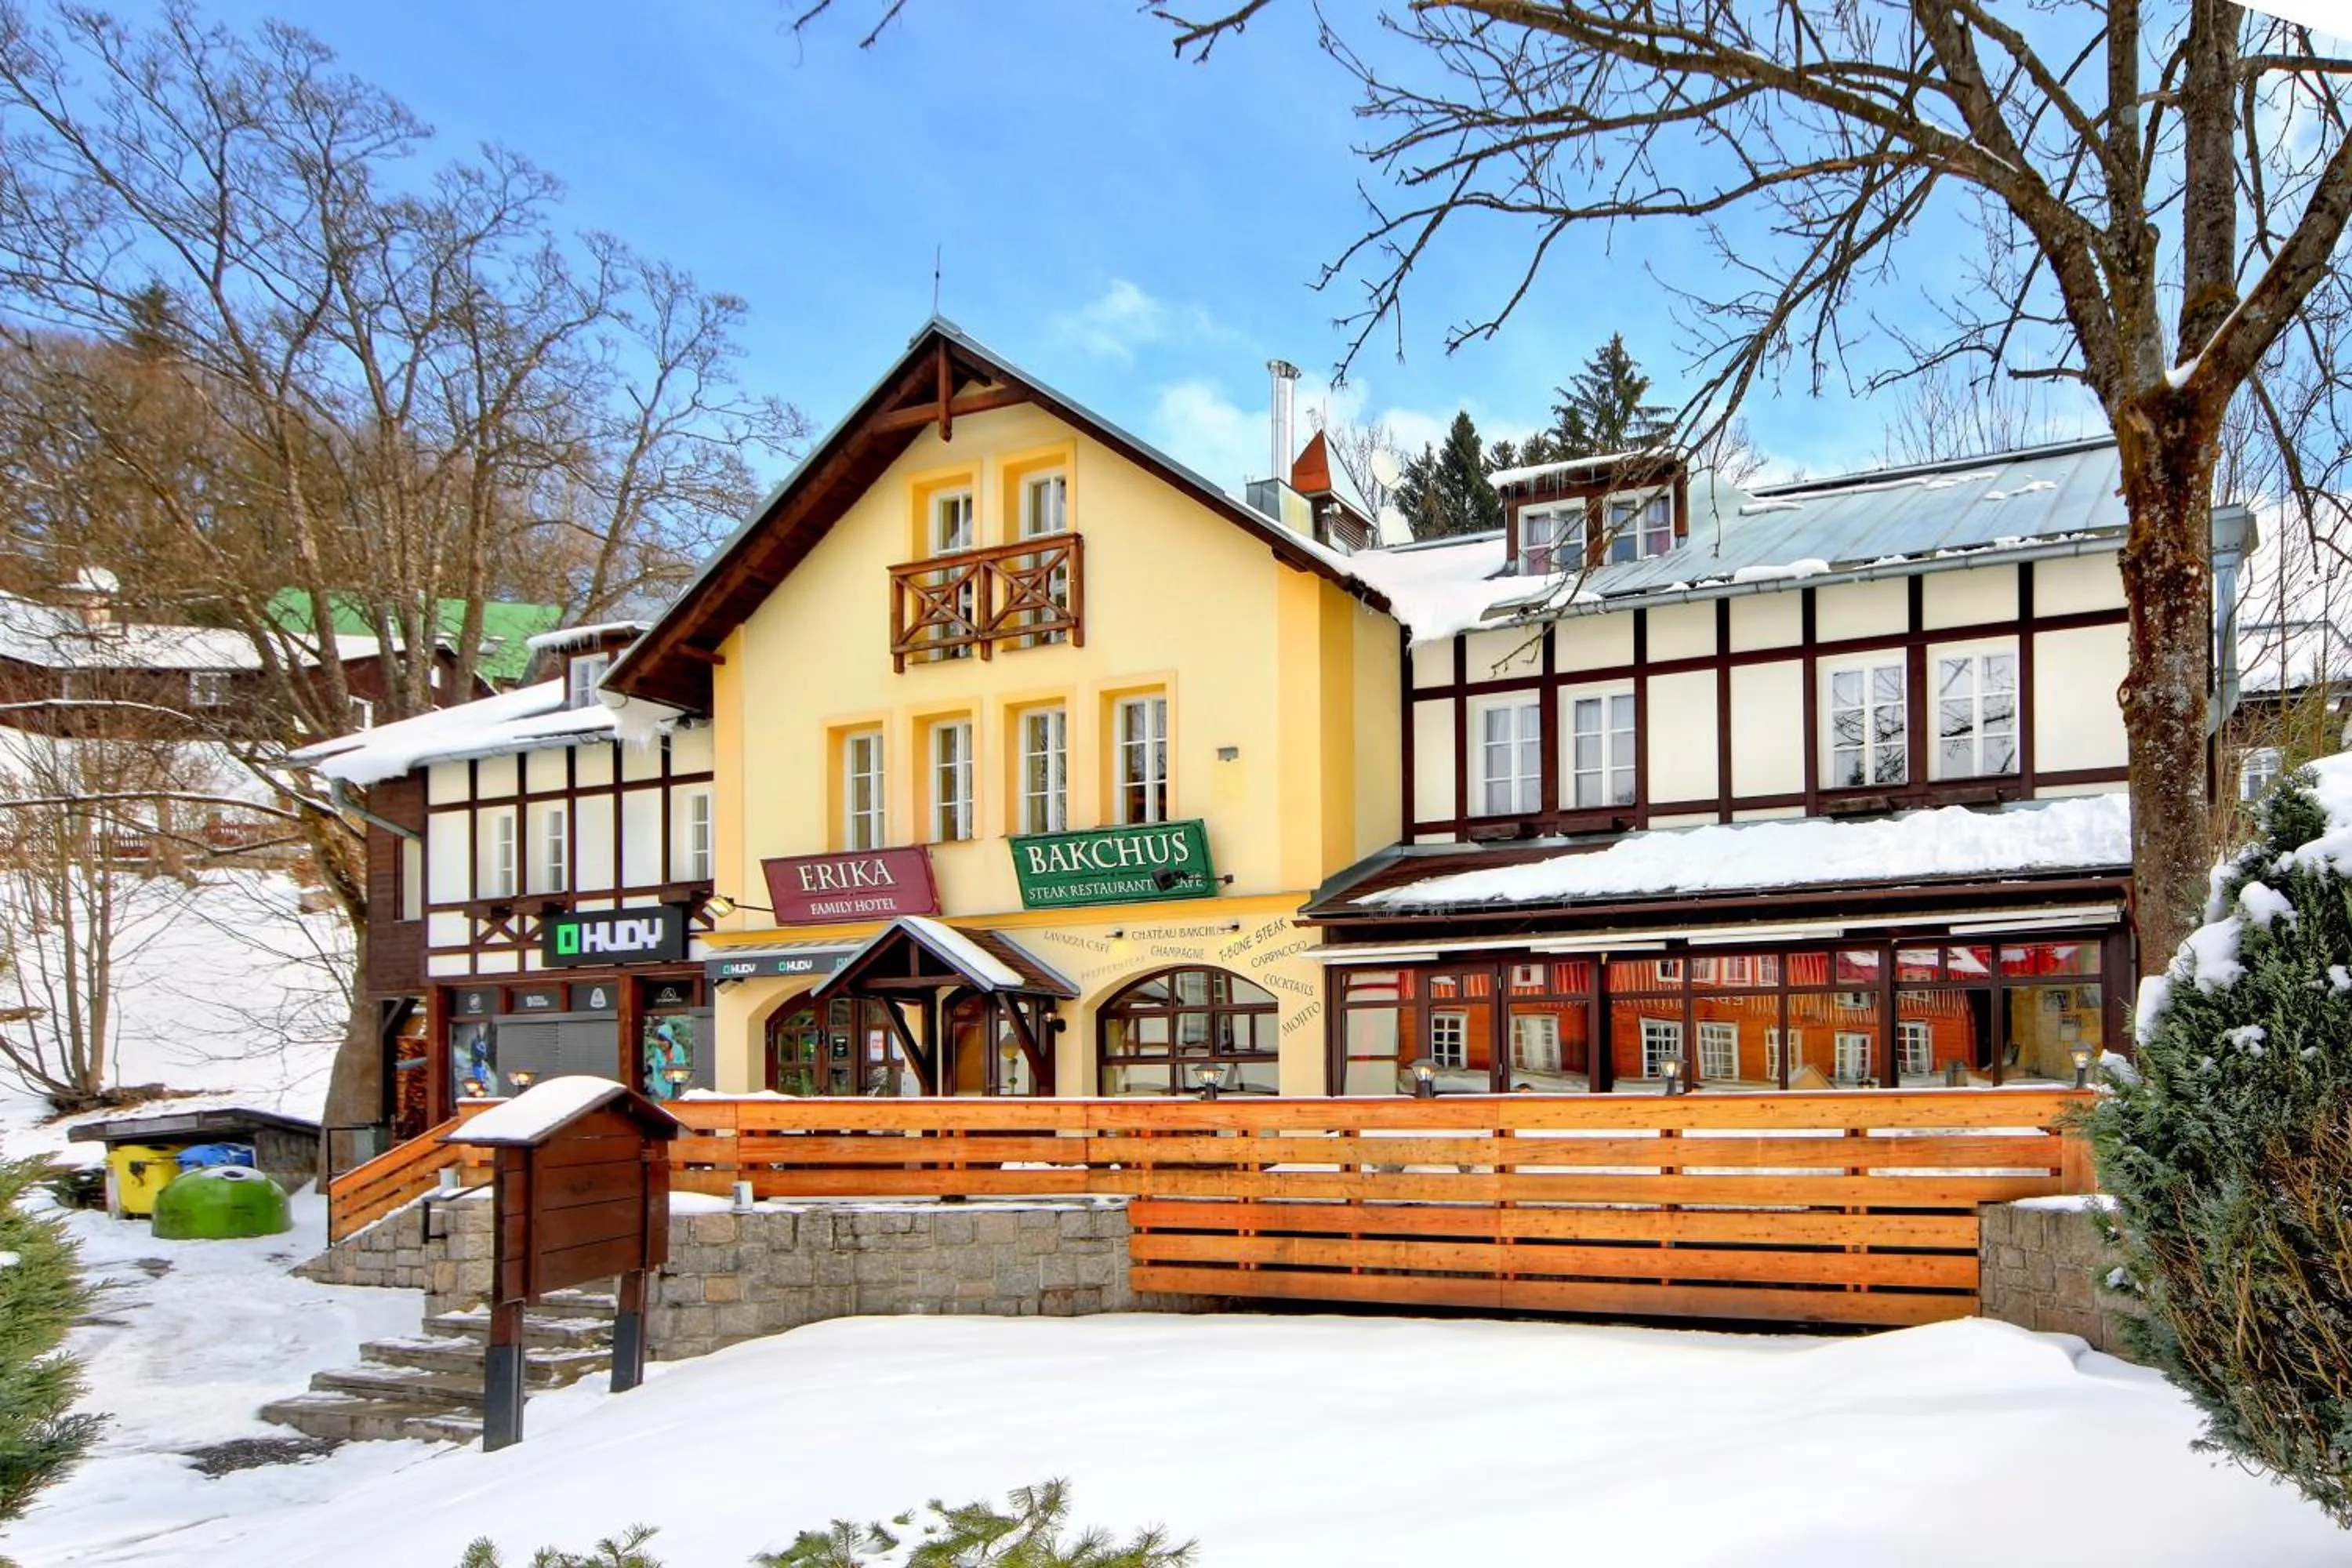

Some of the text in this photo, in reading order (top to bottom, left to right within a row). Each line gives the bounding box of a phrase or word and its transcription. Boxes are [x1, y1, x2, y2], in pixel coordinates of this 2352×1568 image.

[1025, 829, 1189, 875] BAKCHUS
[796, 858, 896, 894] ERIKA
[1028, 883, 1069, 901] STEAK
[1070, 877, 1153, 898] RESTAURANT
[810, 898, 898, 916] FAMILY HOTEL
[581, 918, 663, 953] HUDY
[1219, 917, 1287, 962] T-BONE STEAK
[1150, 945, 1205, 960] CHAMPAGNE
[1250, 940, 1308, 968] CARPACCIO
[1263, 973, 1315, 996] COCKTAILS
[1281, 1001, 1322, 1036] MOJITO
